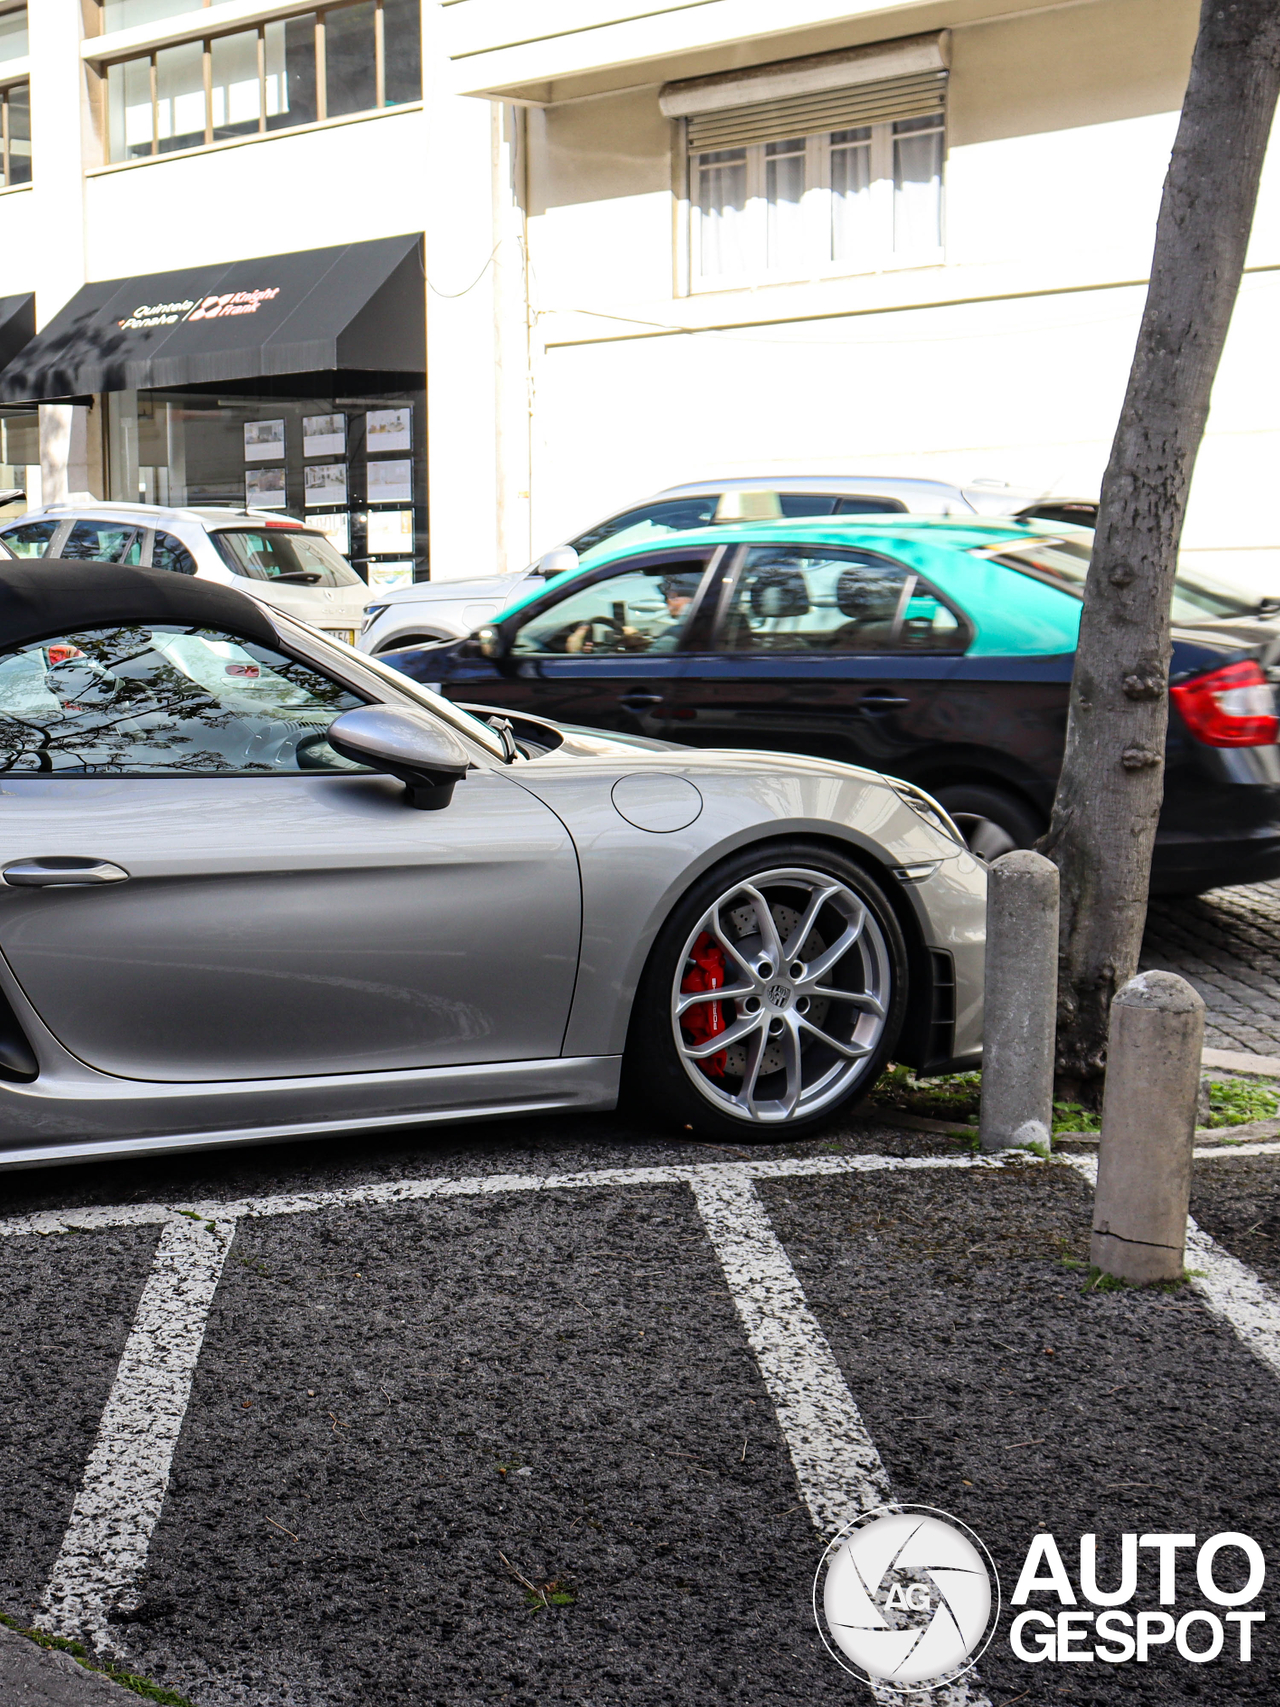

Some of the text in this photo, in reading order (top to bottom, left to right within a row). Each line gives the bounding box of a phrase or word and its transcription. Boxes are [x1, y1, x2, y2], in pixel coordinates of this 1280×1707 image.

[231, 287, 280, 304] Knight
[132, 300, 194, 318] Quintela
[219, 302, 261, 317] Frank
[121, 314, 179, 330] Penalva
